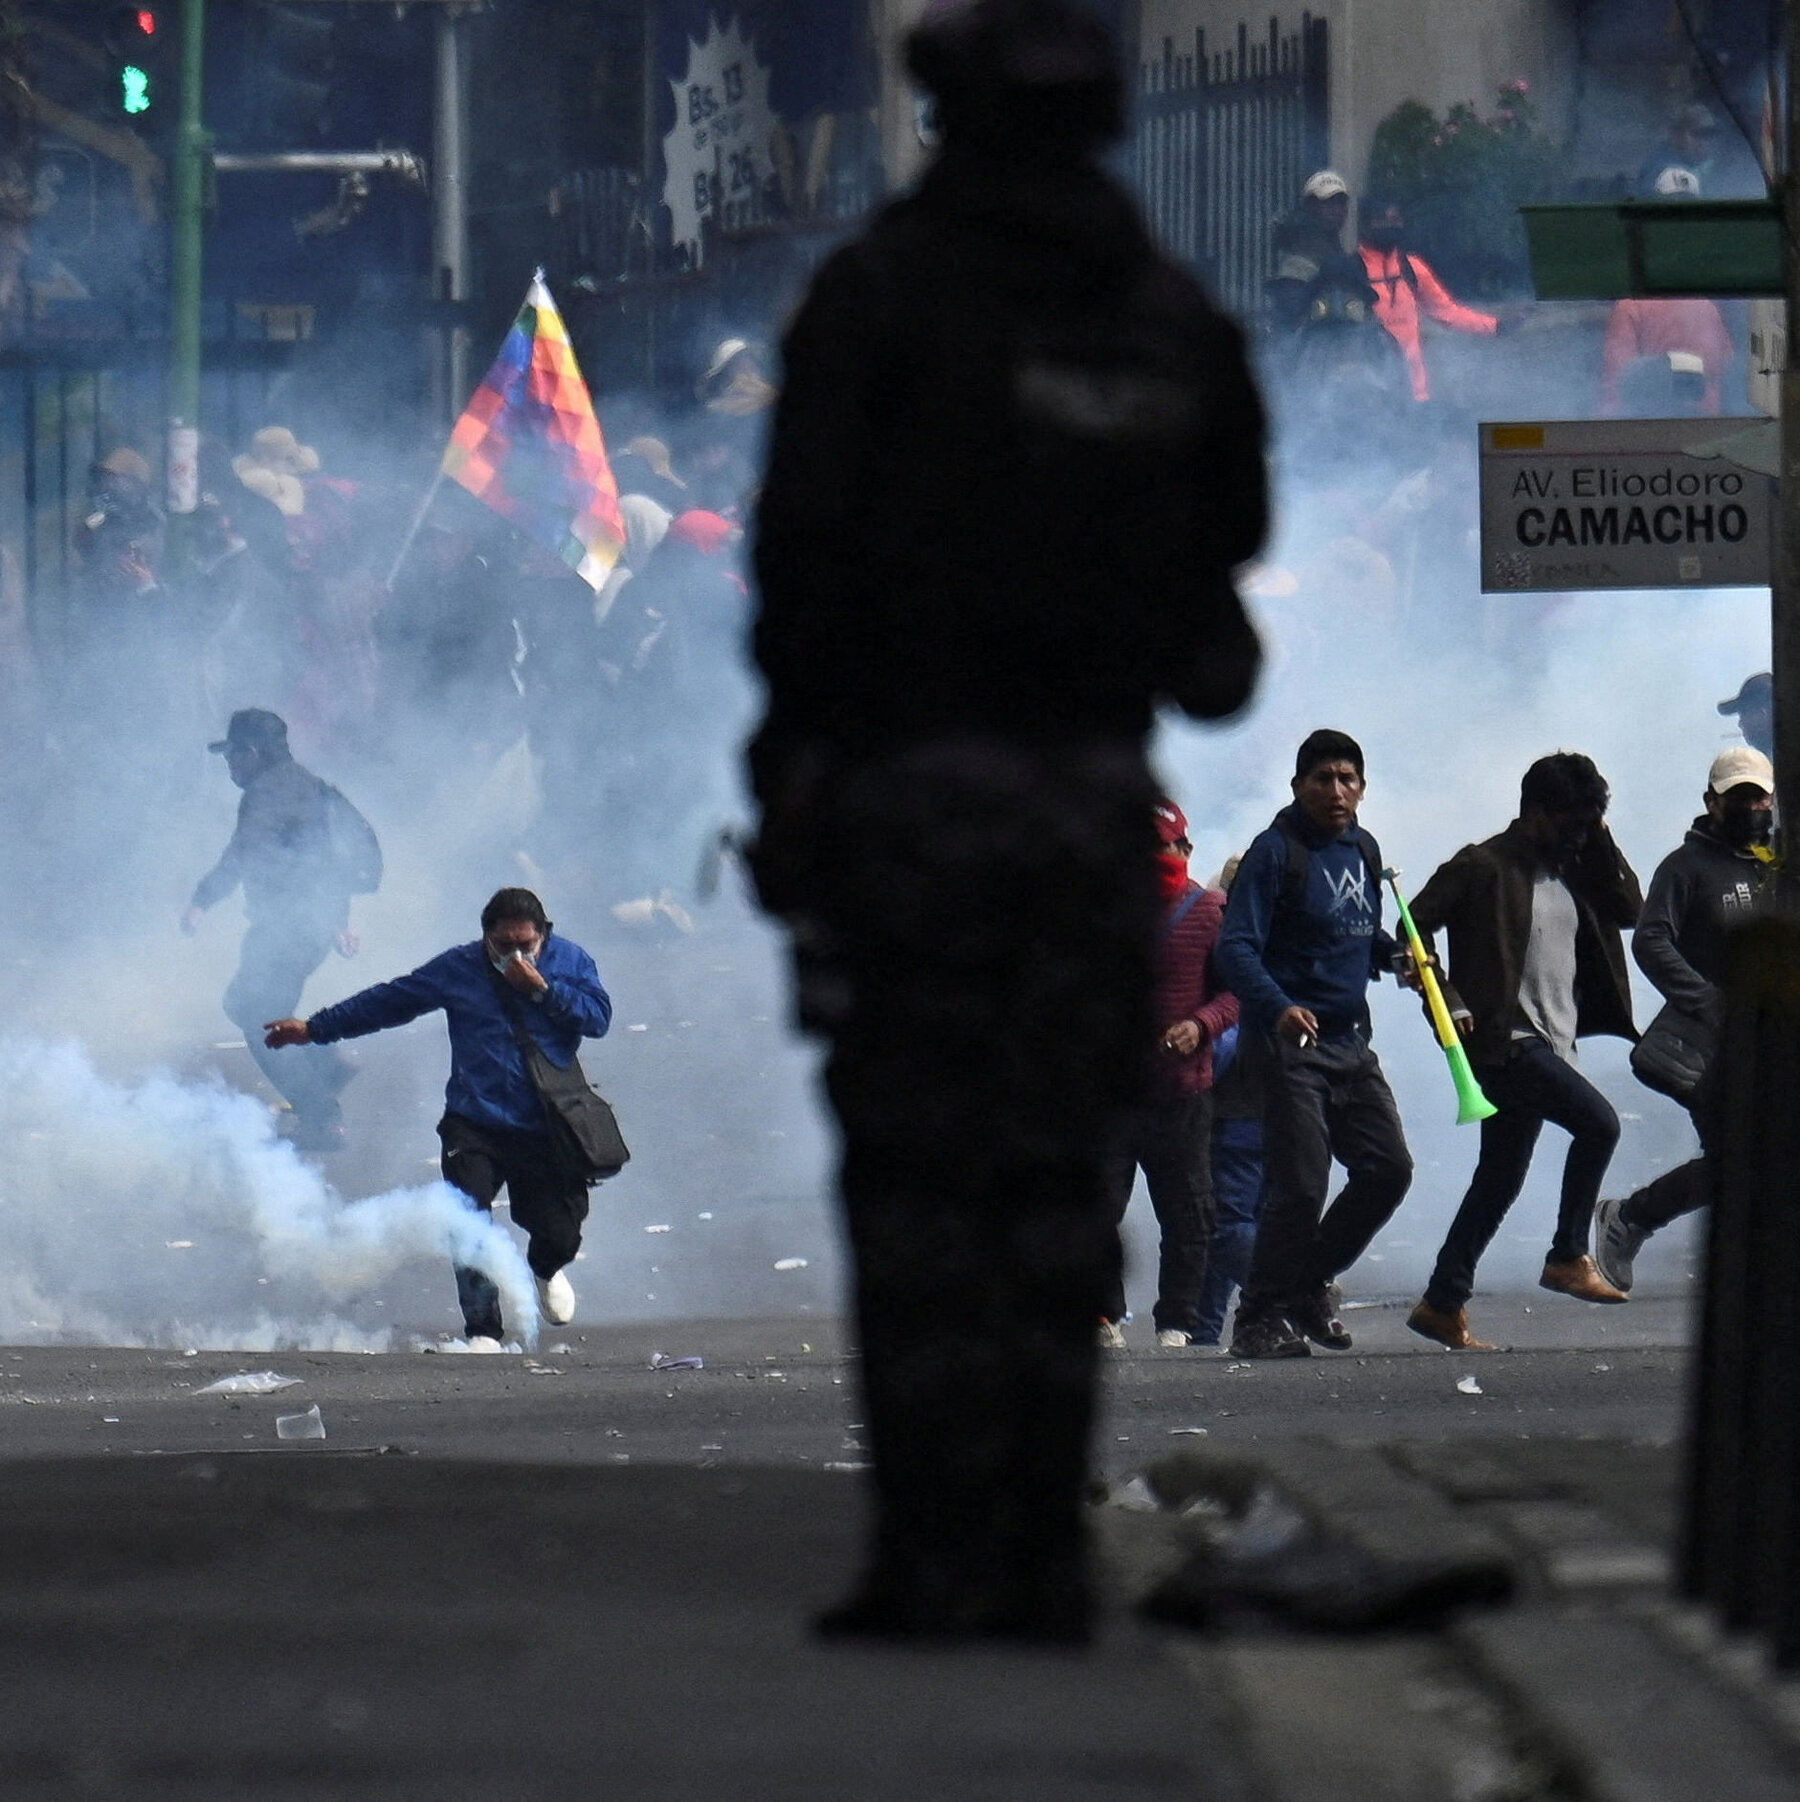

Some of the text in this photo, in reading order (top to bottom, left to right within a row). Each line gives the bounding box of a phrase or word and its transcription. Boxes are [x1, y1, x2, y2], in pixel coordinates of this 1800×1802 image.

[1511, 468, 1744, 498] AV. Eliodoro
[1516, 503, 1748, 548] CAMACHO
